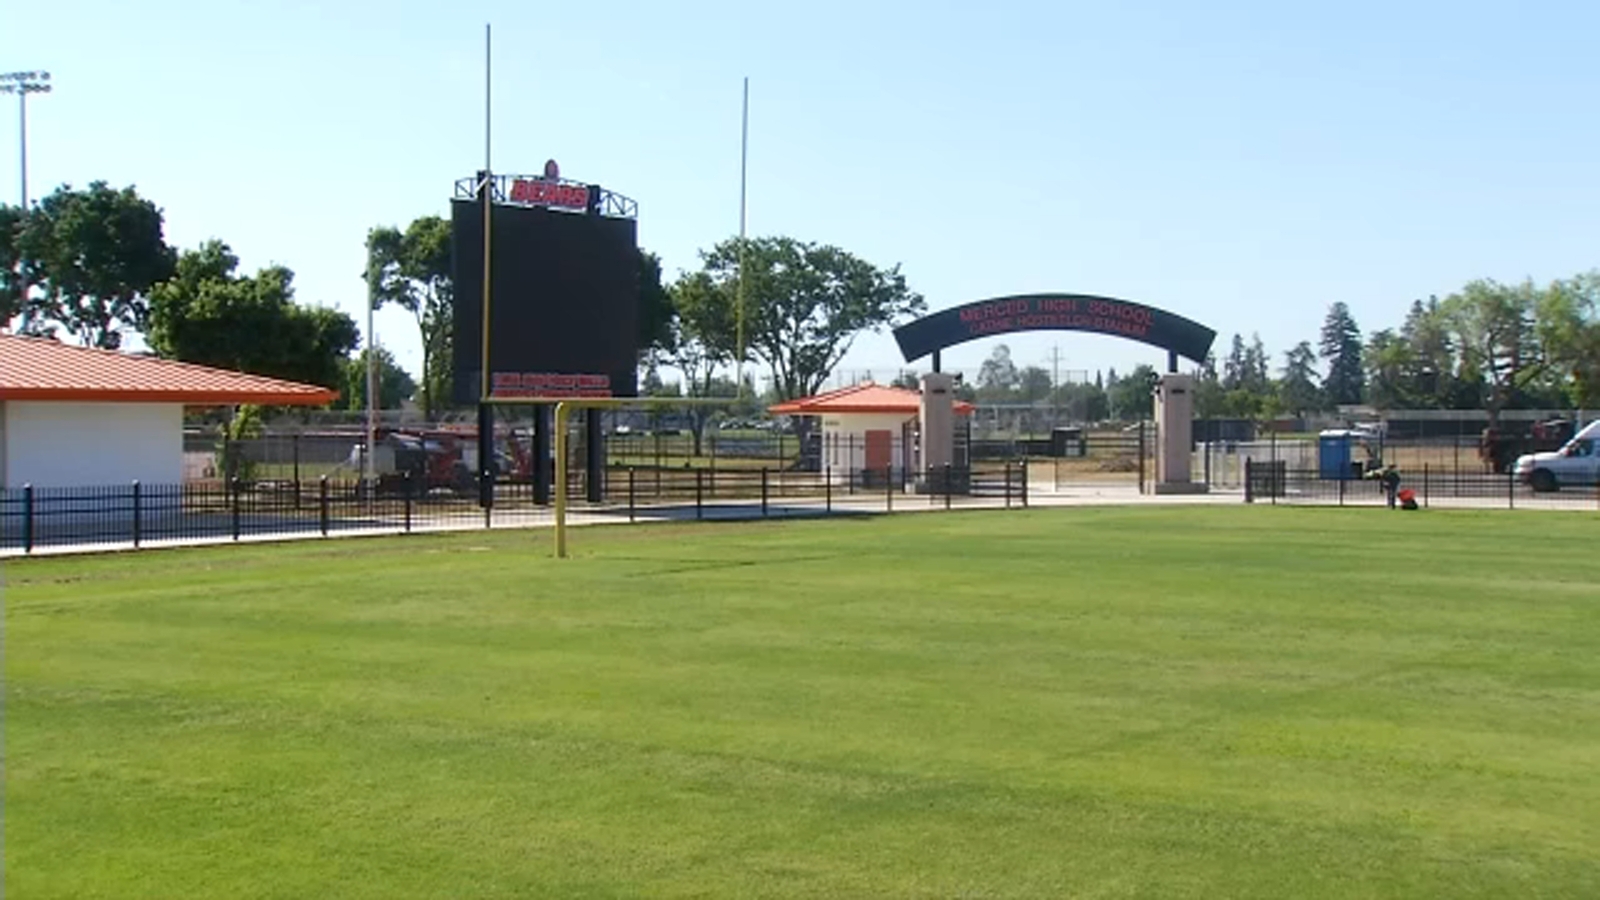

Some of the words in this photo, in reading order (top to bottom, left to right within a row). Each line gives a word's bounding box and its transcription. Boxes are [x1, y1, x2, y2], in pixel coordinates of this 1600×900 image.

[510, 180, 588, 207] BEARS
[960, 300, 1029, 321] MERCED
[1038, 299, 1076, 312] HIGH
[1087, 300, 1155, 326] SCHOOL
